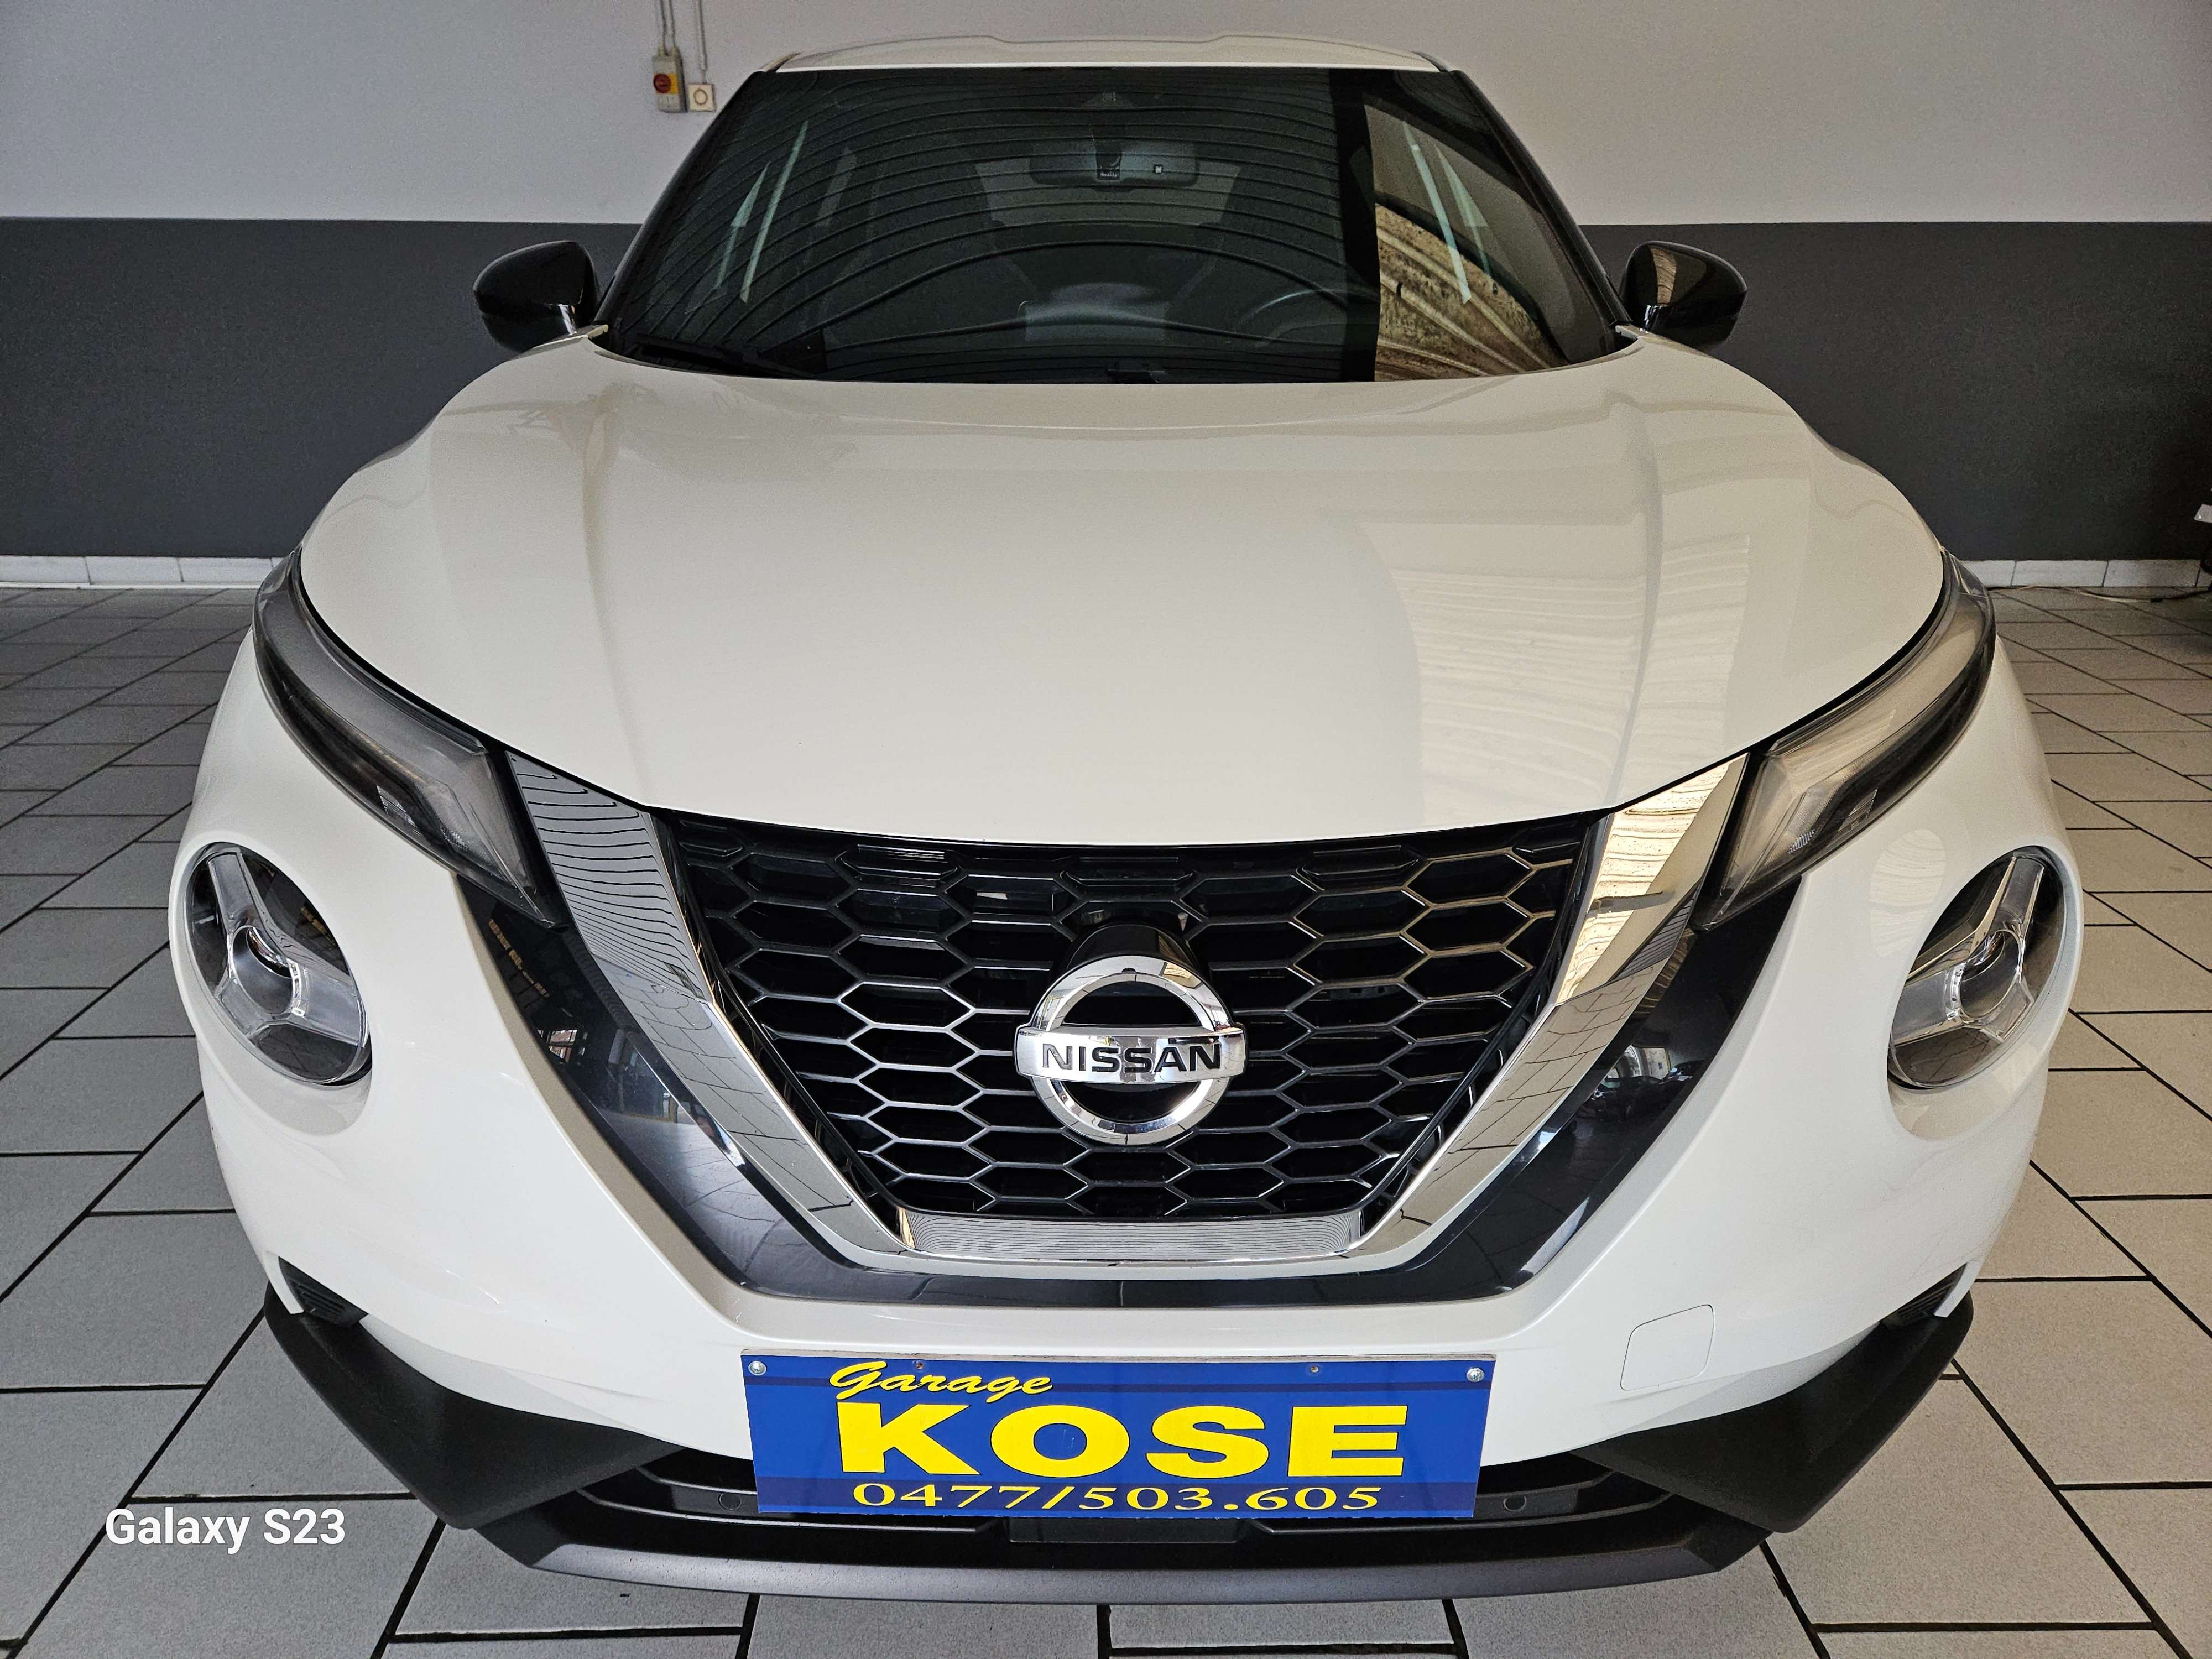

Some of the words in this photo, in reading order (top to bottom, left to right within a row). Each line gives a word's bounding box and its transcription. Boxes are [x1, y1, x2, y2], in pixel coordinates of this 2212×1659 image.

[1042, 1044, 1220, 1073] NISSAN
[828, 1360, 1053, 1404] Garage
[836, 1401, 1407, 1479] KOSE
[852, 1483, 1381, 1511] 0477/503.605
